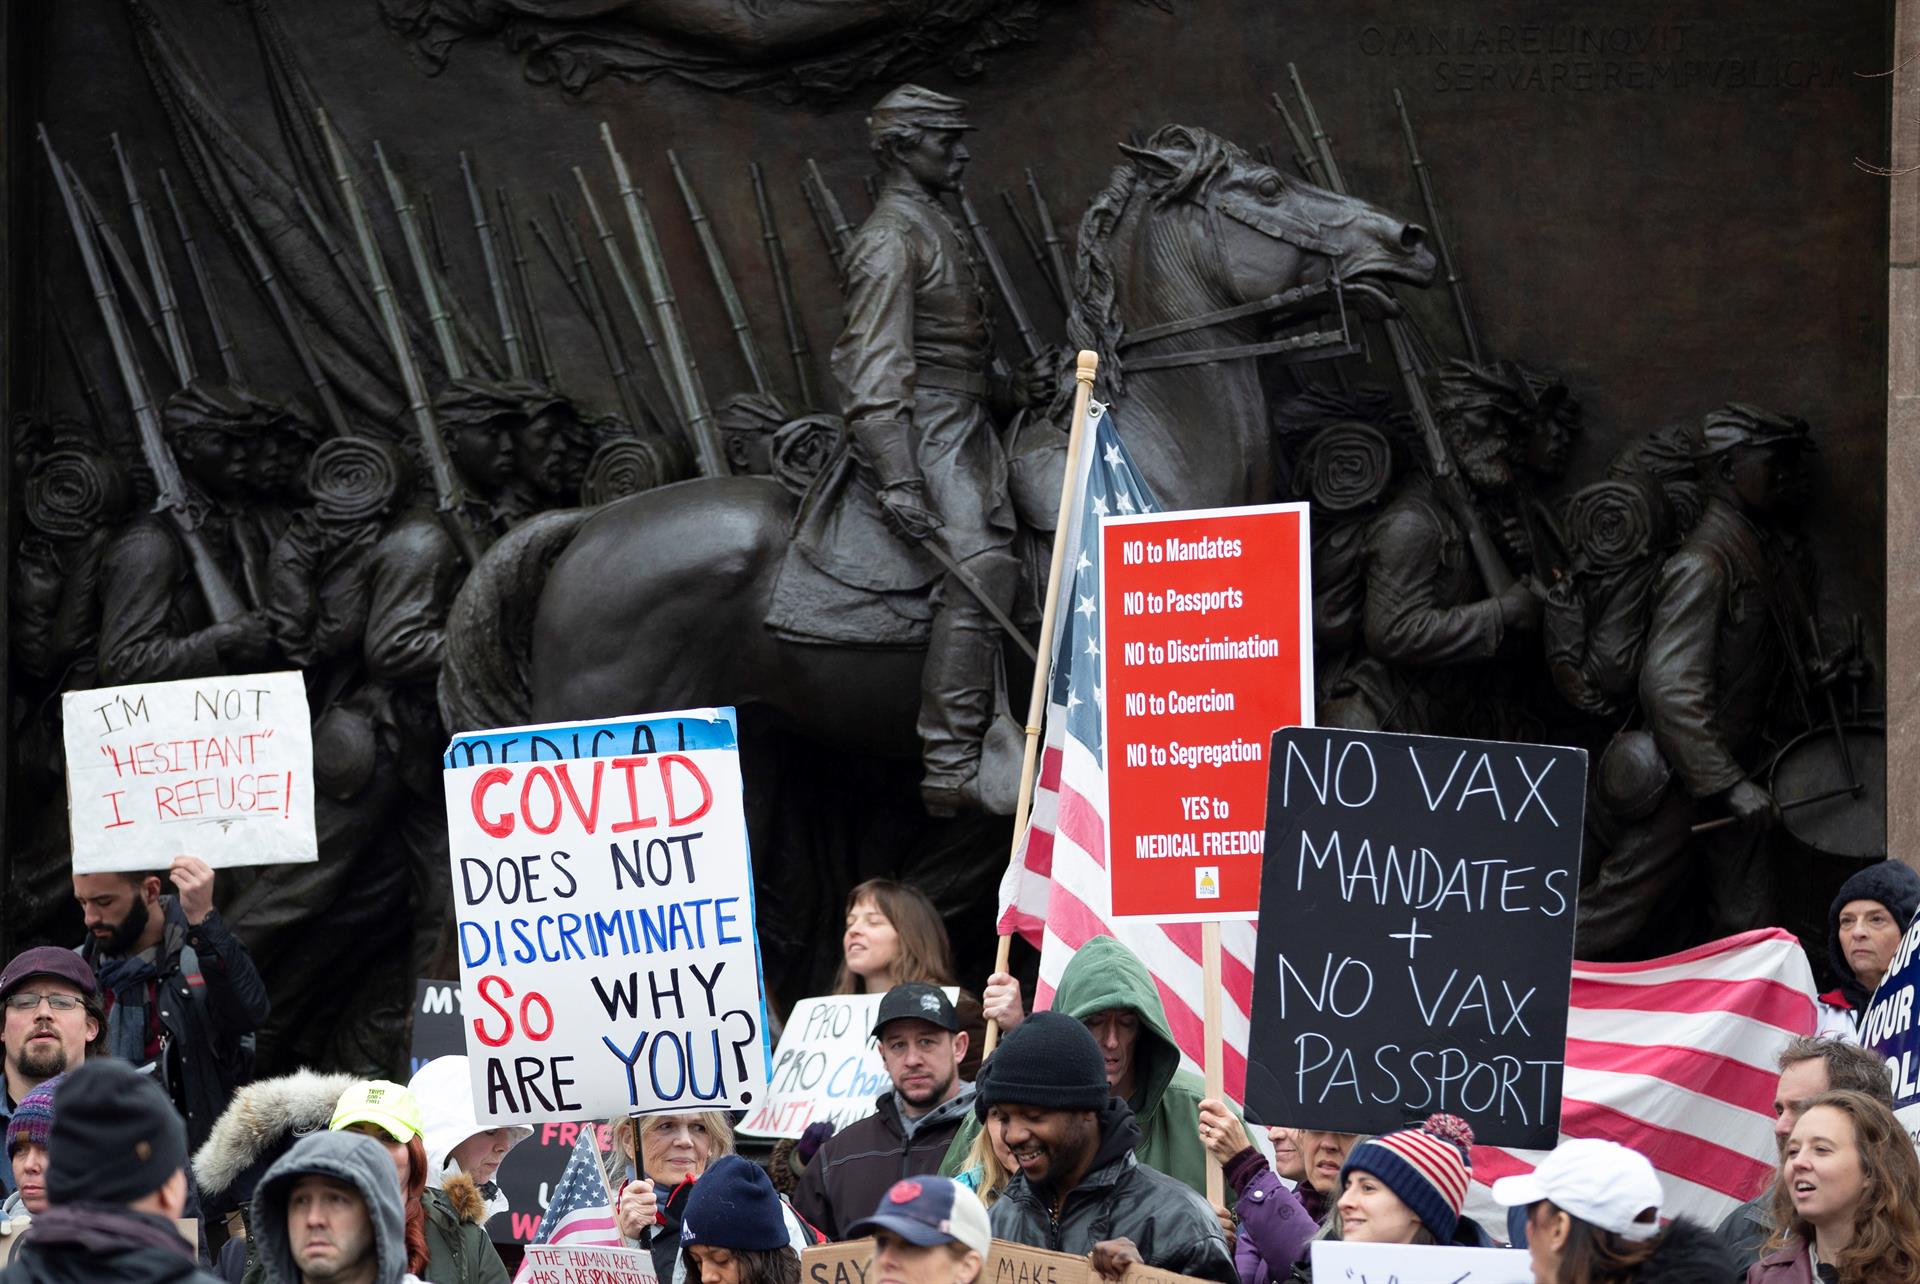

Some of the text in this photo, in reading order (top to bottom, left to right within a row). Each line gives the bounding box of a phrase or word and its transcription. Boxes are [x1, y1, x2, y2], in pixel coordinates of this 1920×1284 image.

[1123, 536, 1242, 565] NO to Mandates
[1124, 587, 1243, 616] NO to Passports
[1124, 634, 1279, 666] NO to Discrimination
[94, 689, 271, 737] I'M NOT
[1125, 688, 1235, 716] NO to Coercion
[1126, 738, 1262, 769] NO to Segregation
[102, 771, 292, 829] I REFUSE!
[471, 754, 713, 839] COVID
[1284, 739, 1559, 827] NO VAX
[1181, 796, 1229, 820] YES to
[460, 832, 703, 905] DOES NOT
[1136, 833, 1200, 859] MEDICAL
[1297, 830, 1568, 916] MANDATES
[459, 897, 742, 968] DISCRIMINATE
[591, 962, 726, 1021] WHY
[1279, 952, 1536, 1037] NO VAX
[802, 1004, 852, 1043] PRO
[487, 1010, 756, 1114] ARE YOU?
[767, 1048, 827, 1094] PRO
[1294, 1032, 1563, 1125] PASSPORT
[530, 1251, 639, 1271] THE HUMAN RACE
[534, 1270, 559, 1284] HAS
[996, 1257, 1057, 1284] MAKE
